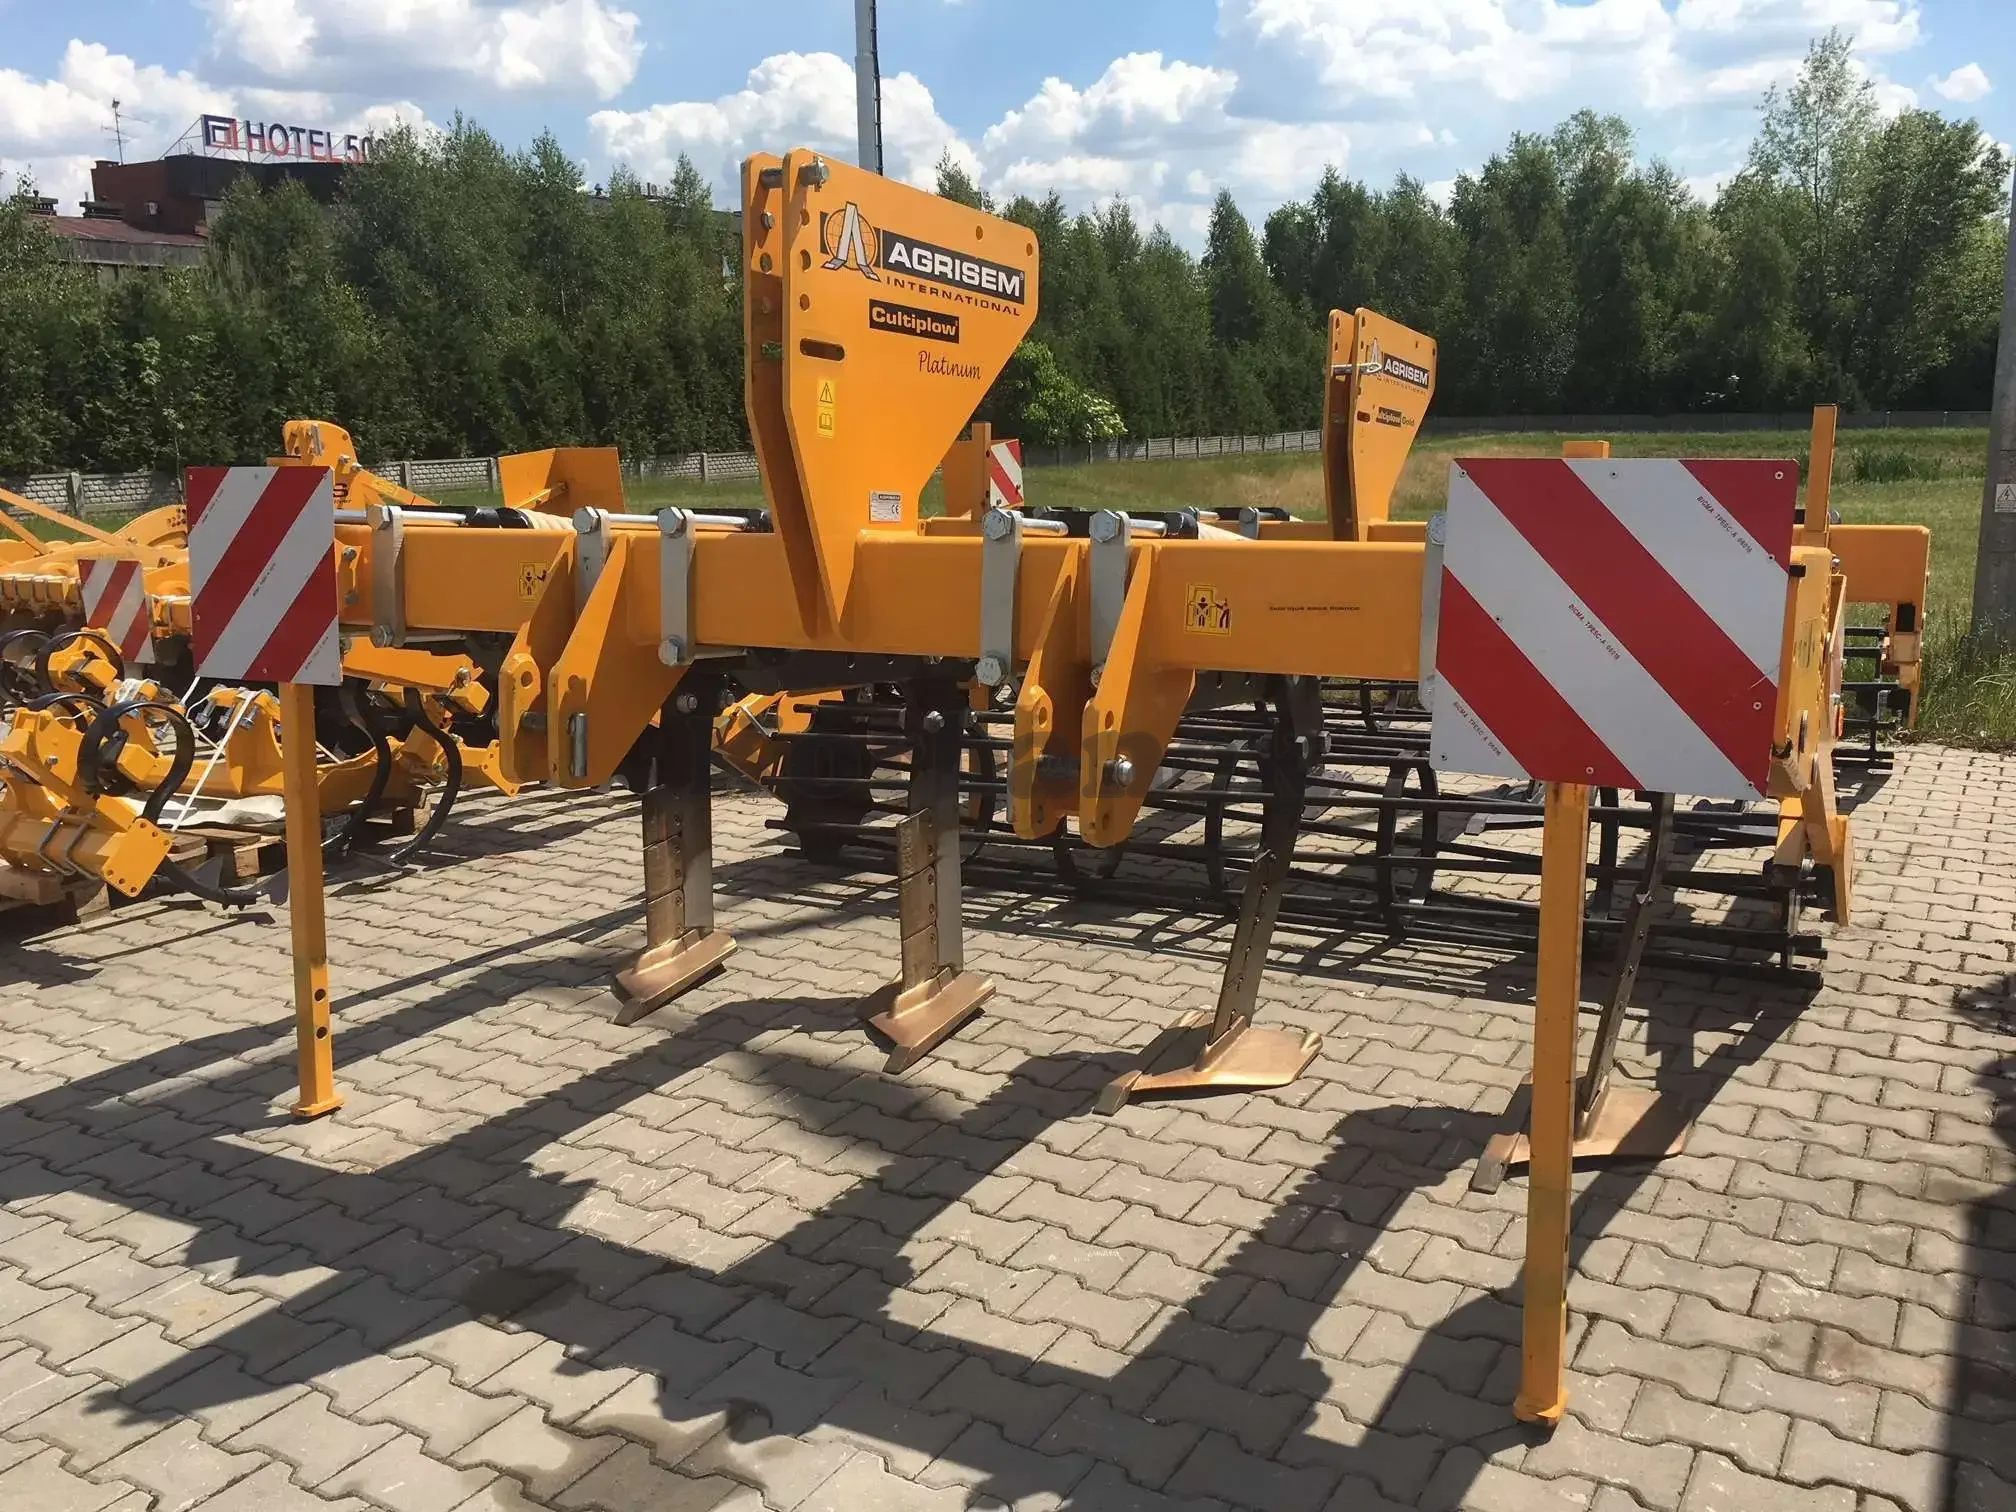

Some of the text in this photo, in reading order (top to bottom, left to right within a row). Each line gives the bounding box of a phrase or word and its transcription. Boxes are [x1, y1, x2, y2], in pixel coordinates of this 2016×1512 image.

[245, 119, 344, 163] HOTEL
[888, 242, 1021, 297] AGRISEM
[886, 275, 1021, 317] INTERNATIONAL
[871, 306, 957, 337] Cultiplow
[918, 350, 982, 381] Platinum
[1384, 358, 1428, 386] AGRISEM
